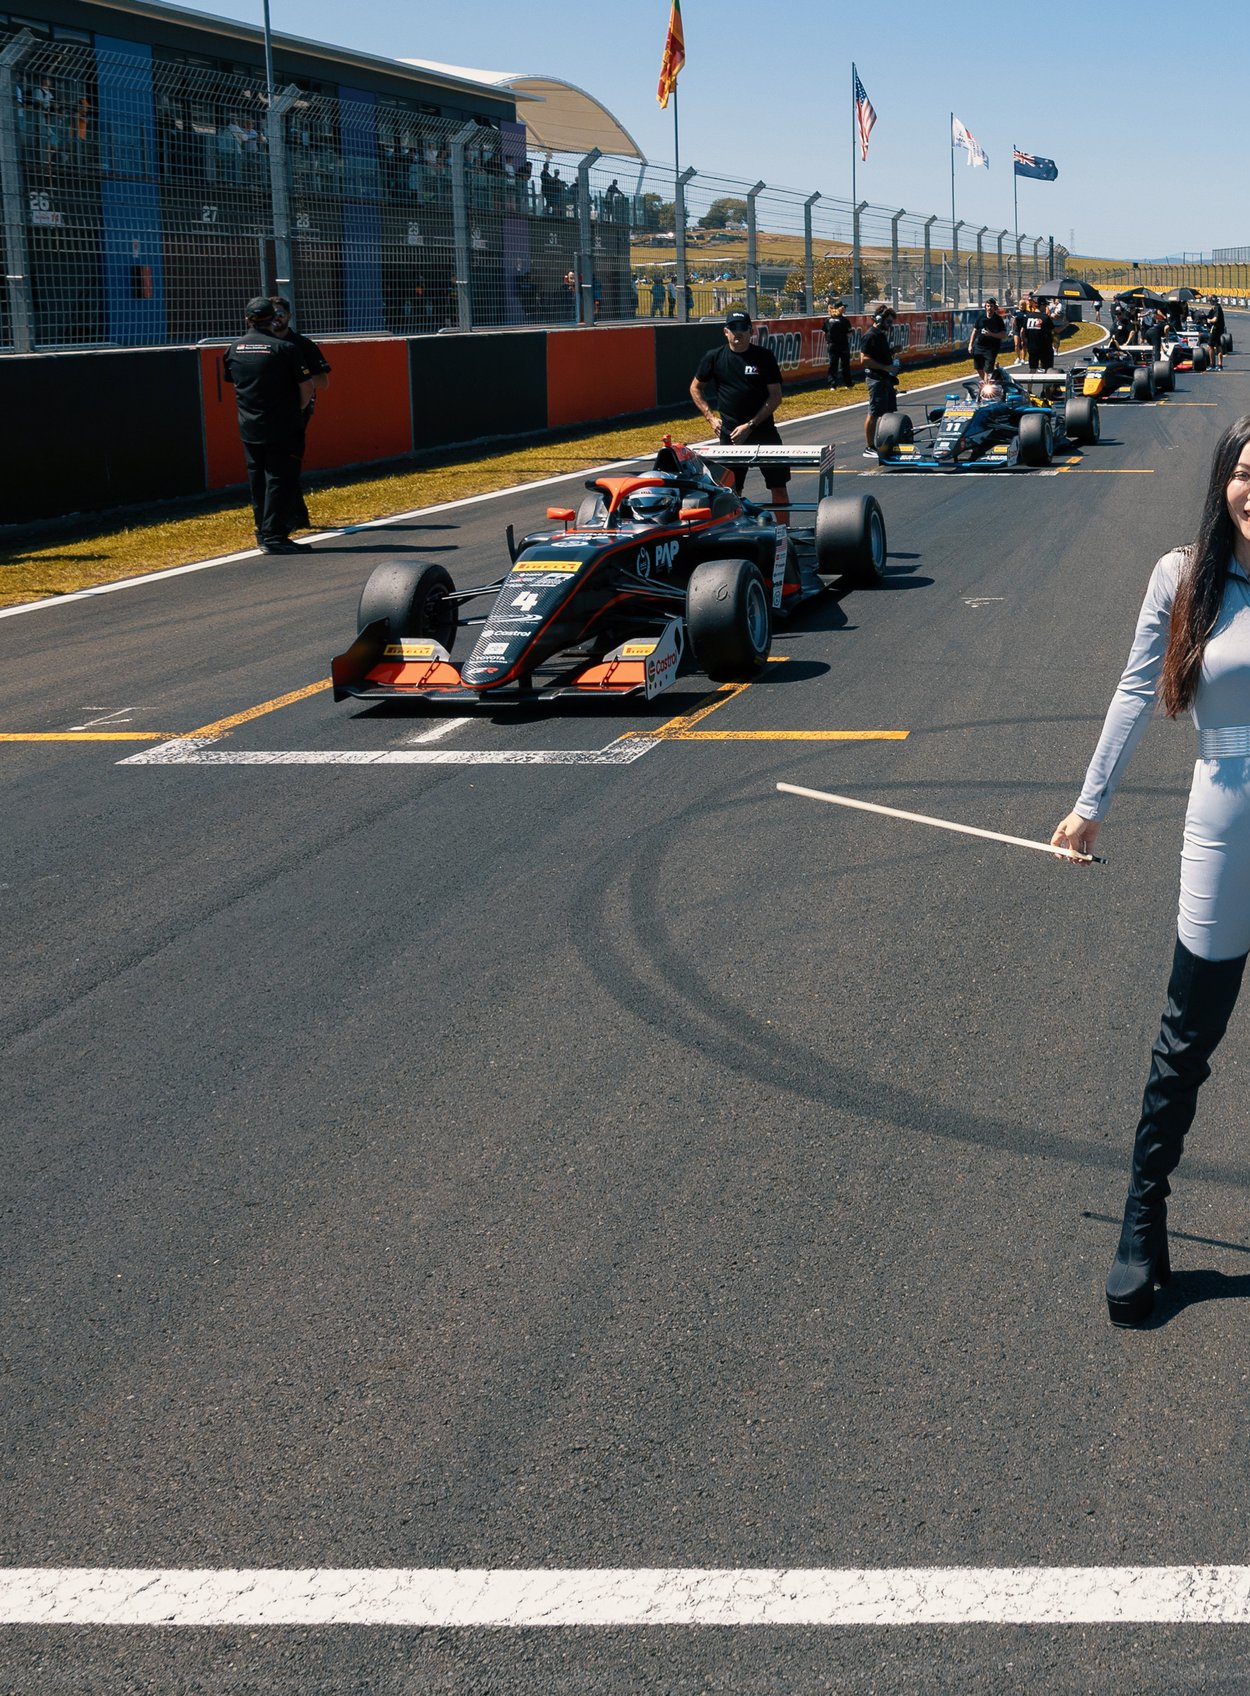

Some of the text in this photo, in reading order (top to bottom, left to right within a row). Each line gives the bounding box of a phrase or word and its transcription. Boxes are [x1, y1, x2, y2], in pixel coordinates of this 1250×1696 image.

[29, 191, 50, 211] 26
[202, 206, 218, 222] 27
[946, 422, 961, 432] 11
[655, 540, 680, 568] PAP
[517, 562, 577, 570] PIRELLI
[510, 591, 539, 612] 4
[656, 649, 678, 675] Castrol
